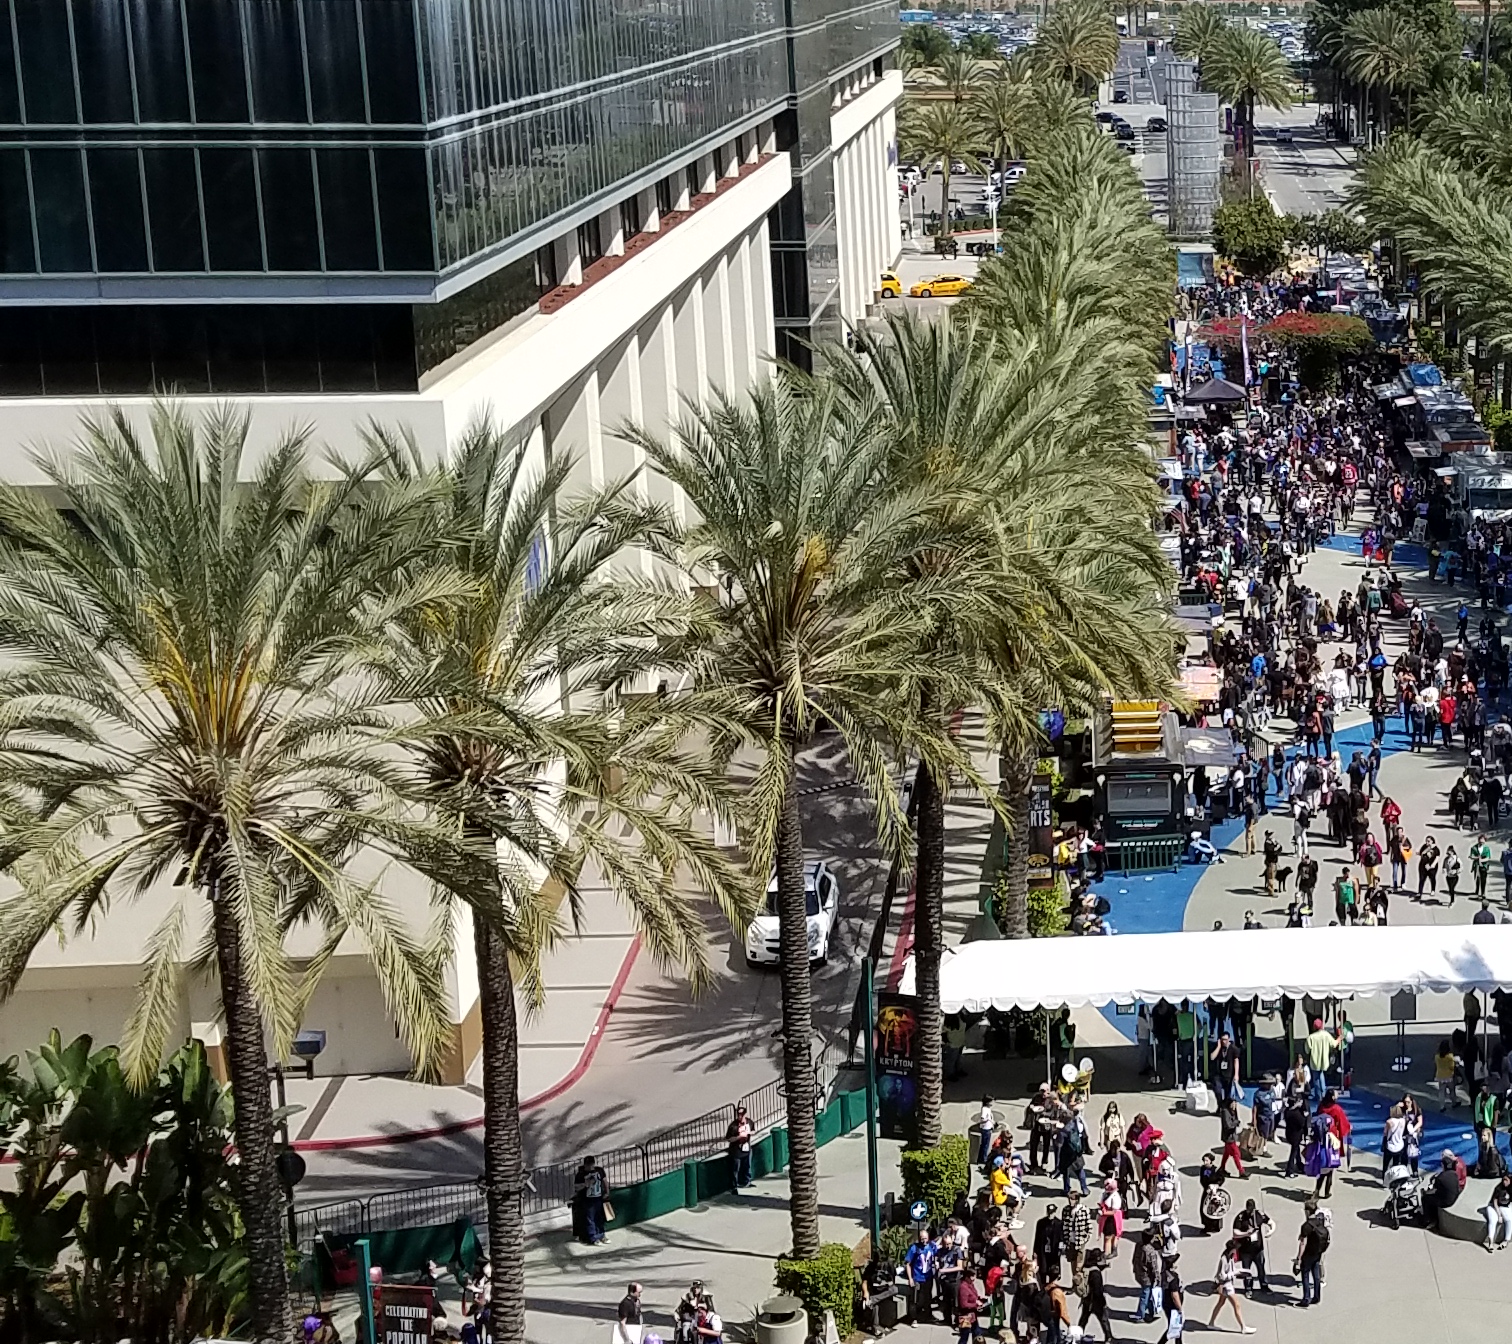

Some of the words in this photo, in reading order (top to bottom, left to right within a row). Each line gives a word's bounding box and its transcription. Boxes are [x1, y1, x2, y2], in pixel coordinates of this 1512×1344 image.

[1030, 809, 1051, 827] RTS
[879, 1056, 914, 1069] KRYPTON
[385, 1304, 428, 1319] CELEBRATING
[400, 1318, 414, 1332] THE
